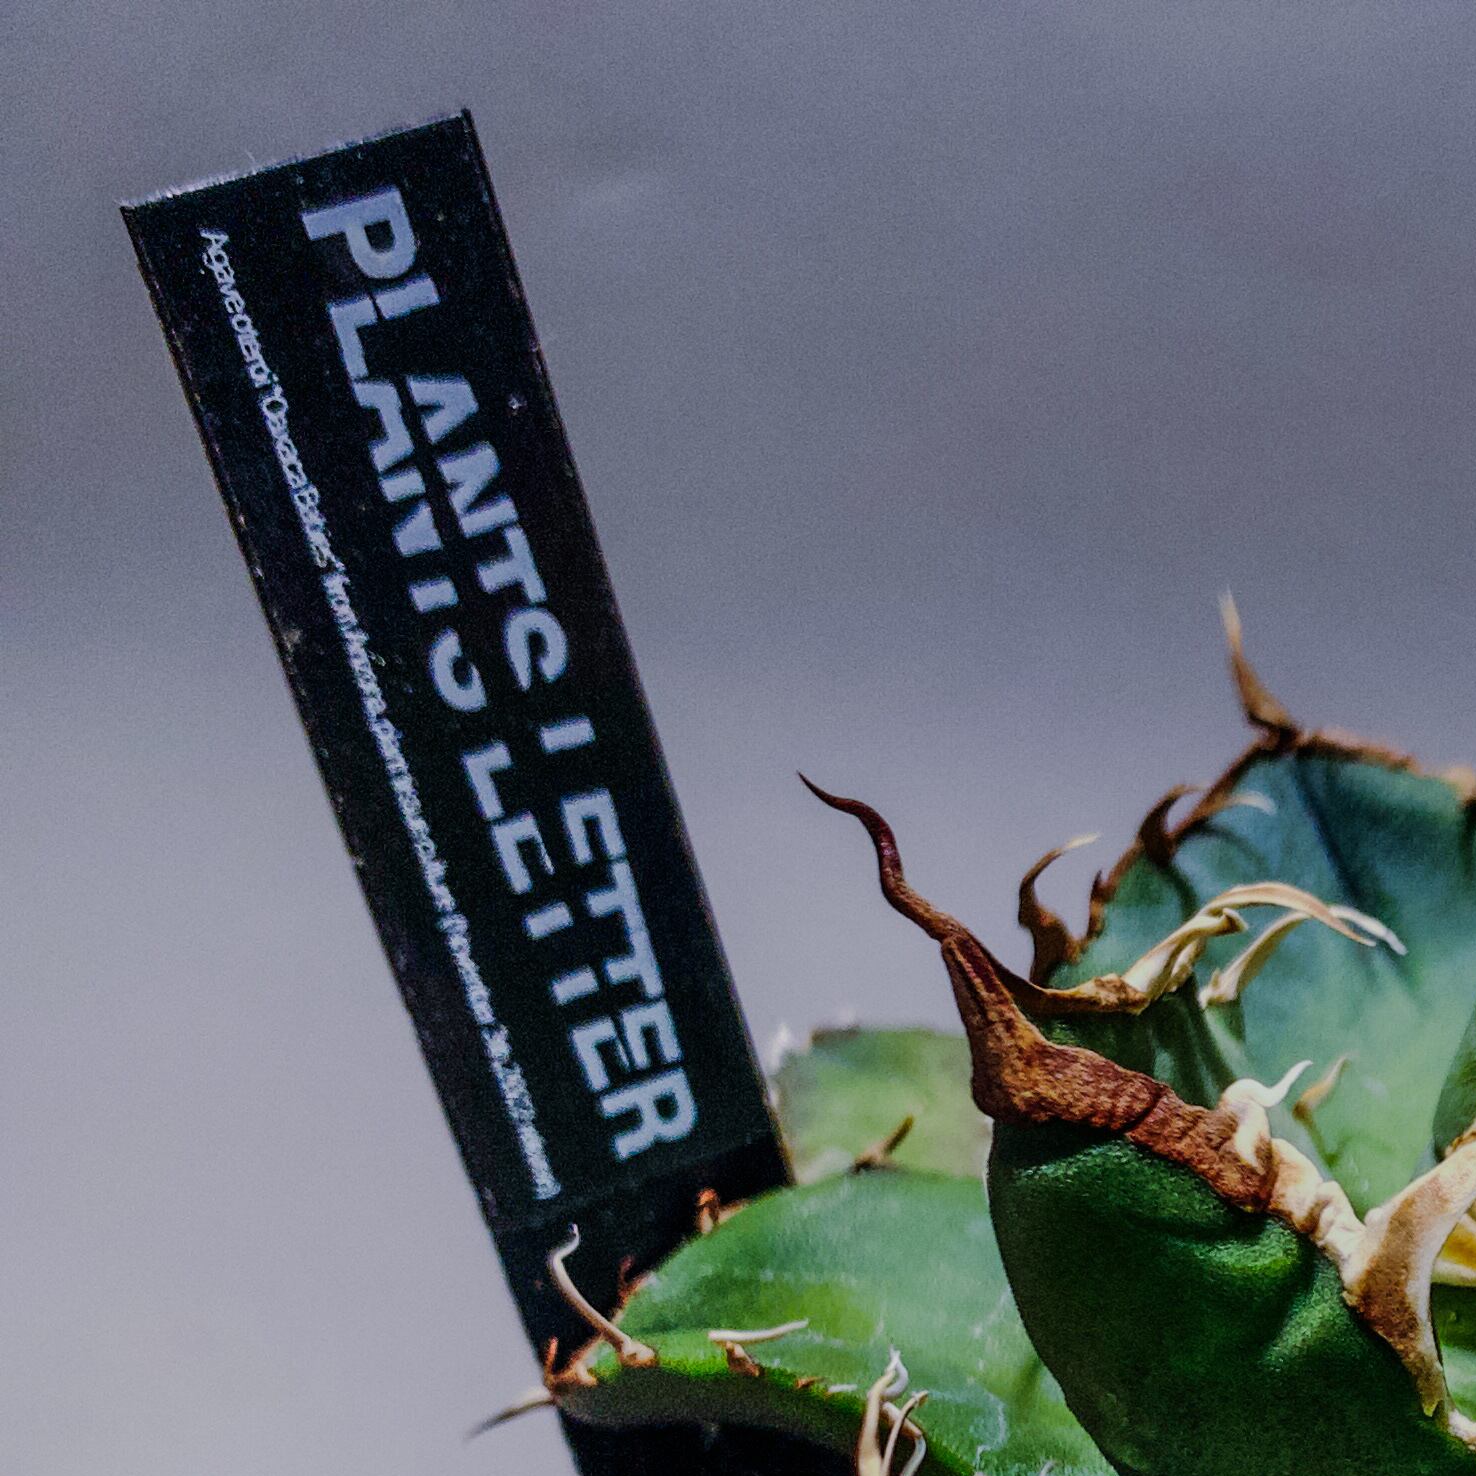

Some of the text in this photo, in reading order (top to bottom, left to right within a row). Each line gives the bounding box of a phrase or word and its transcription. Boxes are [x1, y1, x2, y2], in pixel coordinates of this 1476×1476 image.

[201, 230, 245, 313] Agave
[302, 189, 696, 1158] PLANTS LETTER
